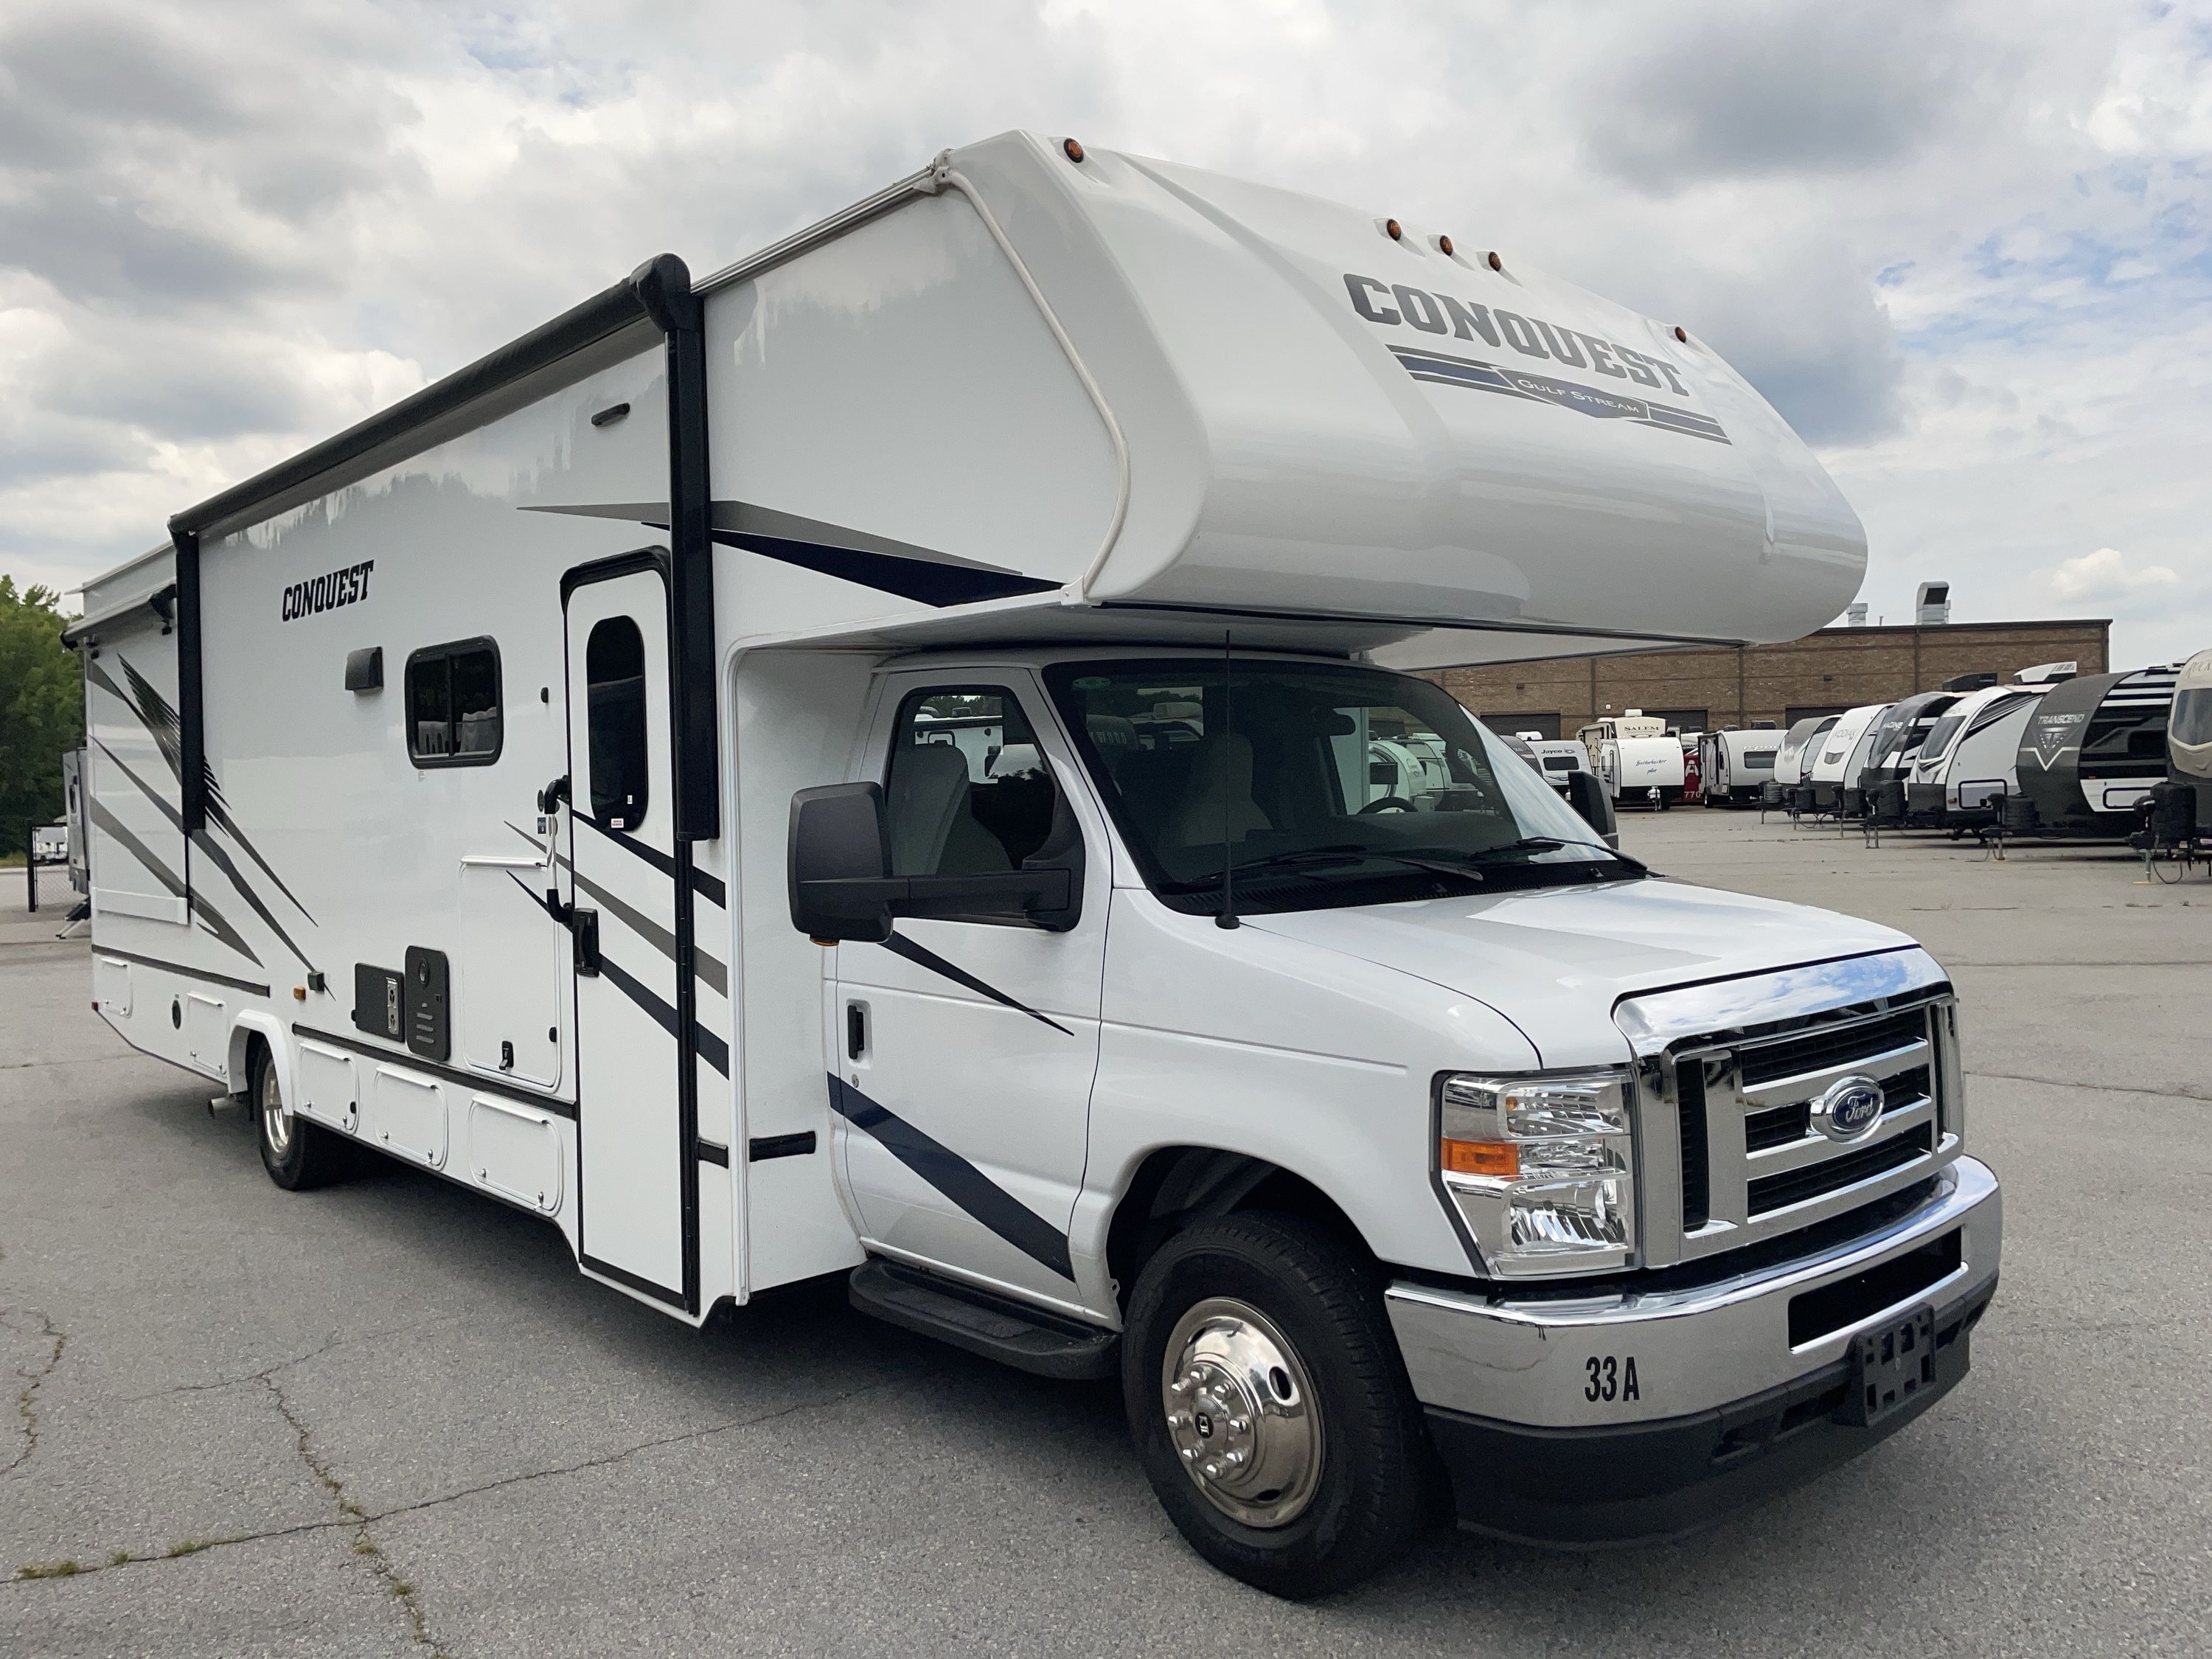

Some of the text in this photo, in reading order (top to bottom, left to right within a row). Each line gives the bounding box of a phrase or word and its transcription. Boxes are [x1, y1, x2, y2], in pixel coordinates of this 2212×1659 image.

[1343, 274, 1689, 397] CONQUEST
[1517, 379, 1639, 413] GULF STREAM
[282, 560, 375, 622] CONQUEST
[2038, 714, 2084, 724] TRANSCEND
[1846, 1094, 1873, 1123] Ford
